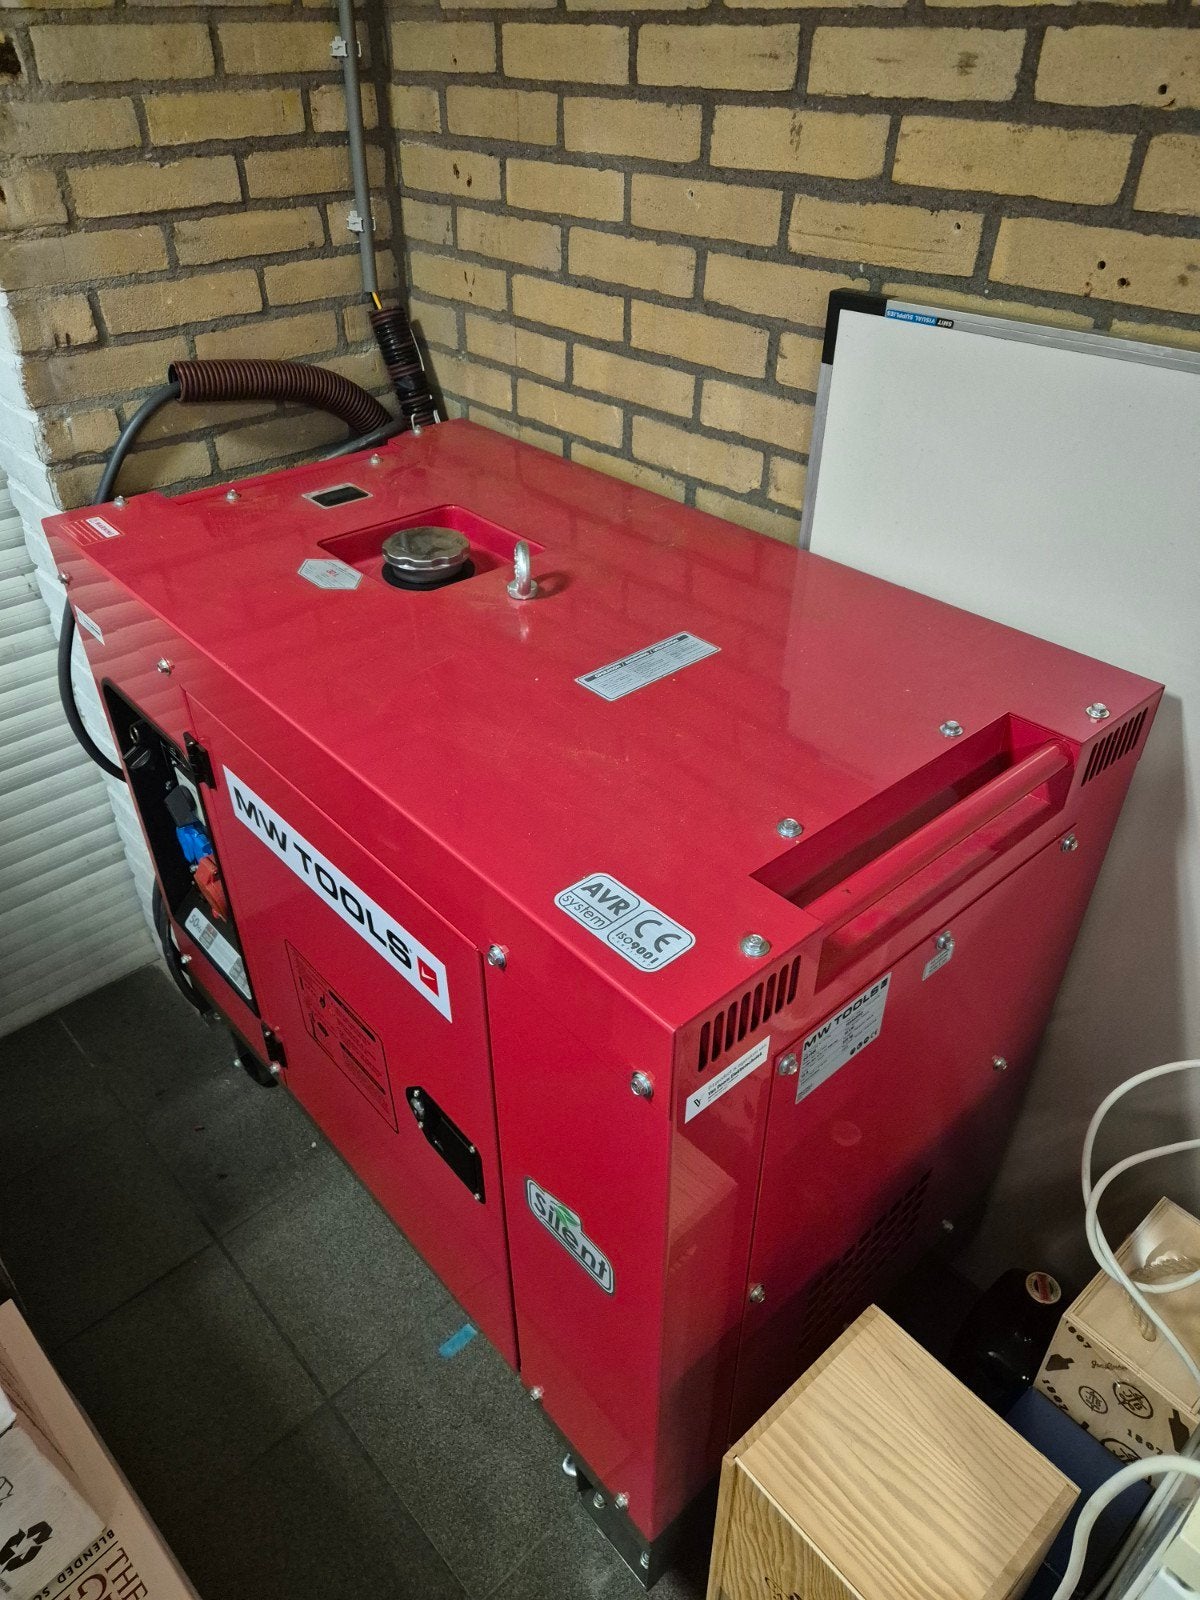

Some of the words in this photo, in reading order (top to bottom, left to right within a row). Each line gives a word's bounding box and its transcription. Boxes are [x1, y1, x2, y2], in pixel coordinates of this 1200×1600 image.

[886, 310, 913, 320] SUPPLIES
[915, 315, 936, 325] VISUAL
[233, 785, 287, 853] MW
[293, 842, 412, 970] TOOLS
[562, 894, 606, 928] system
[580, 882, 631, 916] AVR
[634, 919, 682, 953] CE
[803, 1022, 832, 1051] MW
[834, 985, 880, 1026] TOOLS
[533, 1191, 608, 1280] Silent
[57, 1529, 115, 1584] BLENDED
